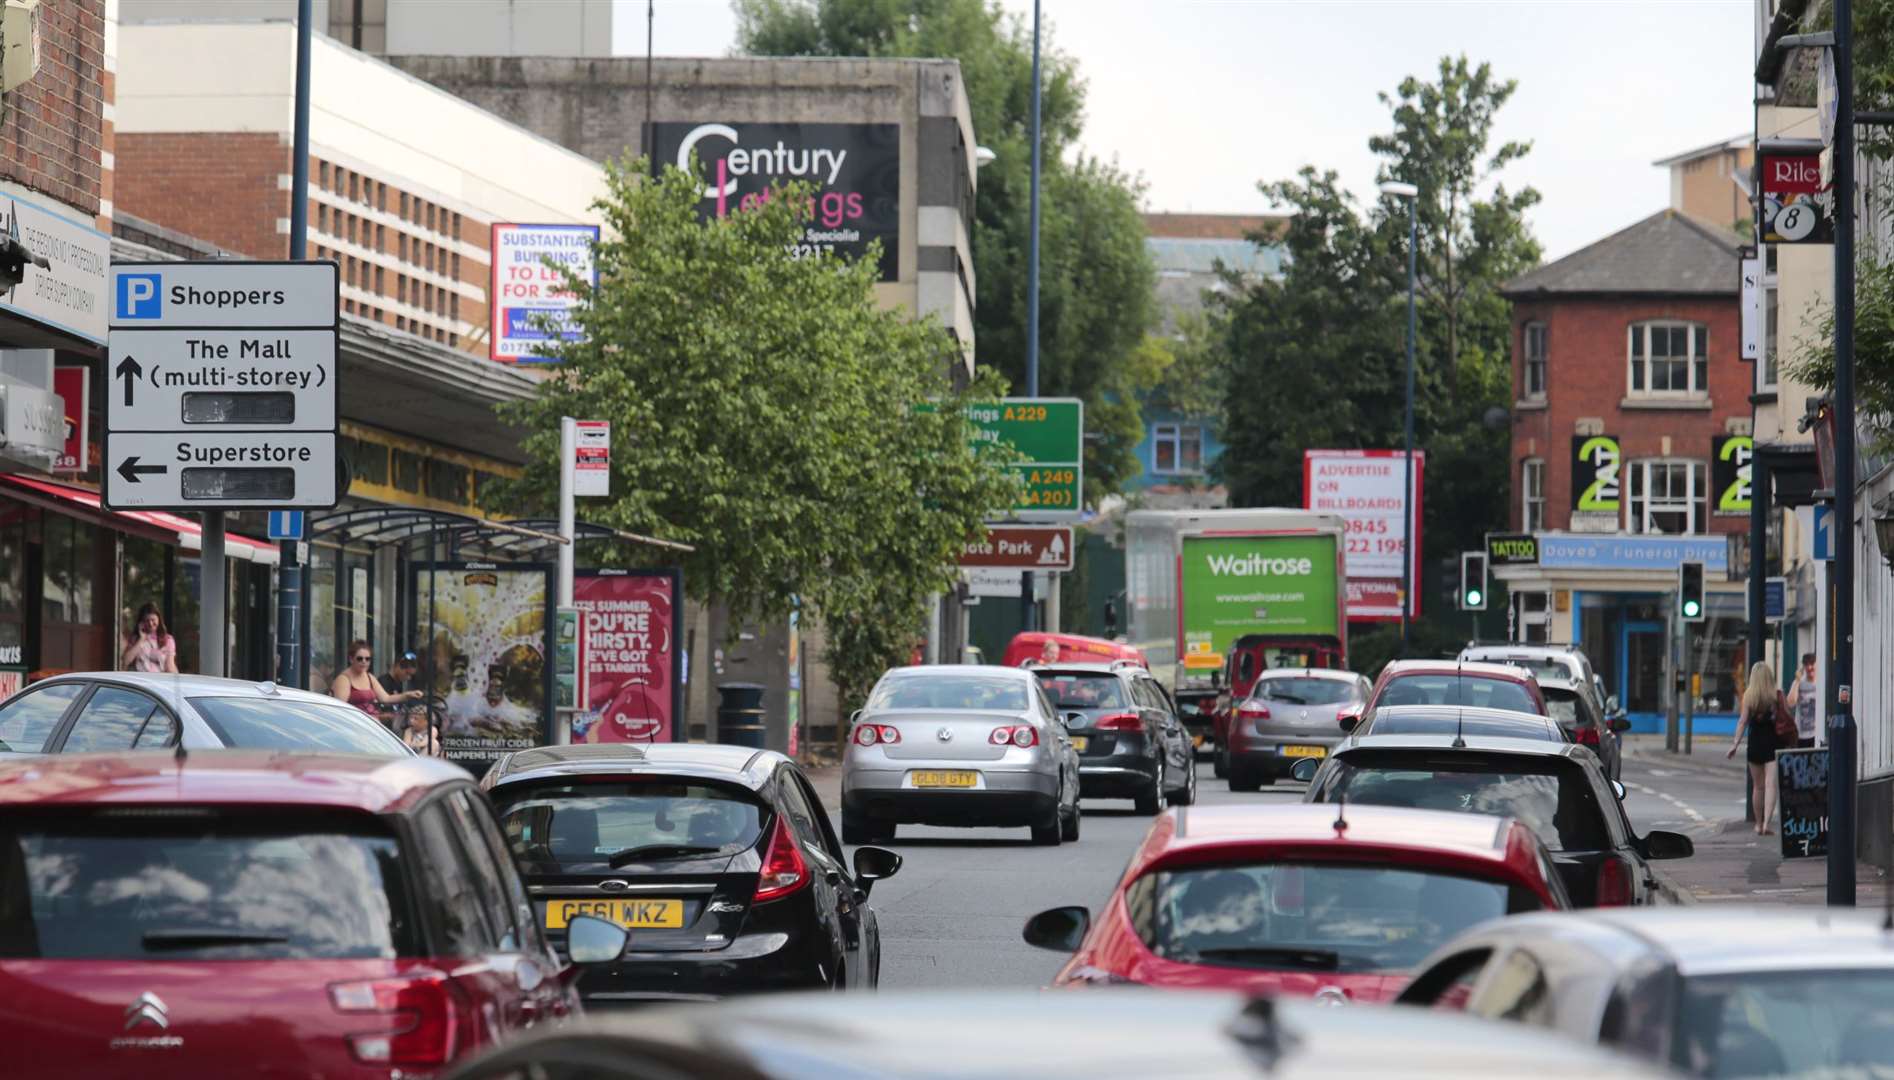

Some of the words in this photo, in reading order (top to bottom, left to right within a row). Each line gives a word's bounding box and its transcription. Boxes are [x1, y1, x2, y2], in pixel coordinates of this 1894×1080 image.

[677, 124, 847, 198] Century
[806, 229, 860, 242] Specialist
[508, 266, 533, 281] TO
[170, 285, 285, 307] Shoppers
[503, 284, 539, 298] FOR
[186, 340, 229, 359] The
[240, 339, 292, 359] Mall
[150, 364, 327, 388] (multi-storey)
[1004, 406, 1047, 421] A229
[176, 442, 312, 465] Superstore
[1031, 470, 1073, 484] A249
[1318, 464, 1391, 477] ADVERTISE
[1317, 481, 1339, 494] ON
[1317, 497, 1404, 510] BILLBOARDS
[963, 541, 993, 555] ote
[998, 540, 1033, 555] Park
[1490, 540, 1535, 557] TATTOO
[1613, 544, 1678, 560] Funeral
[1206, 553, 1312, 577] Waitrose
[1216, 591, 1304, 602] www.waitrose.com
[597, 600, 652, 612] SUMMER.
[619, 650, 649, 662] GOT
[448, 751, 487, 760] HAPPENS
[1783, 817, 1818, 840] July
[1798, 840, 1810, 856] 7
[621, 903, 668, 923] WKZ
